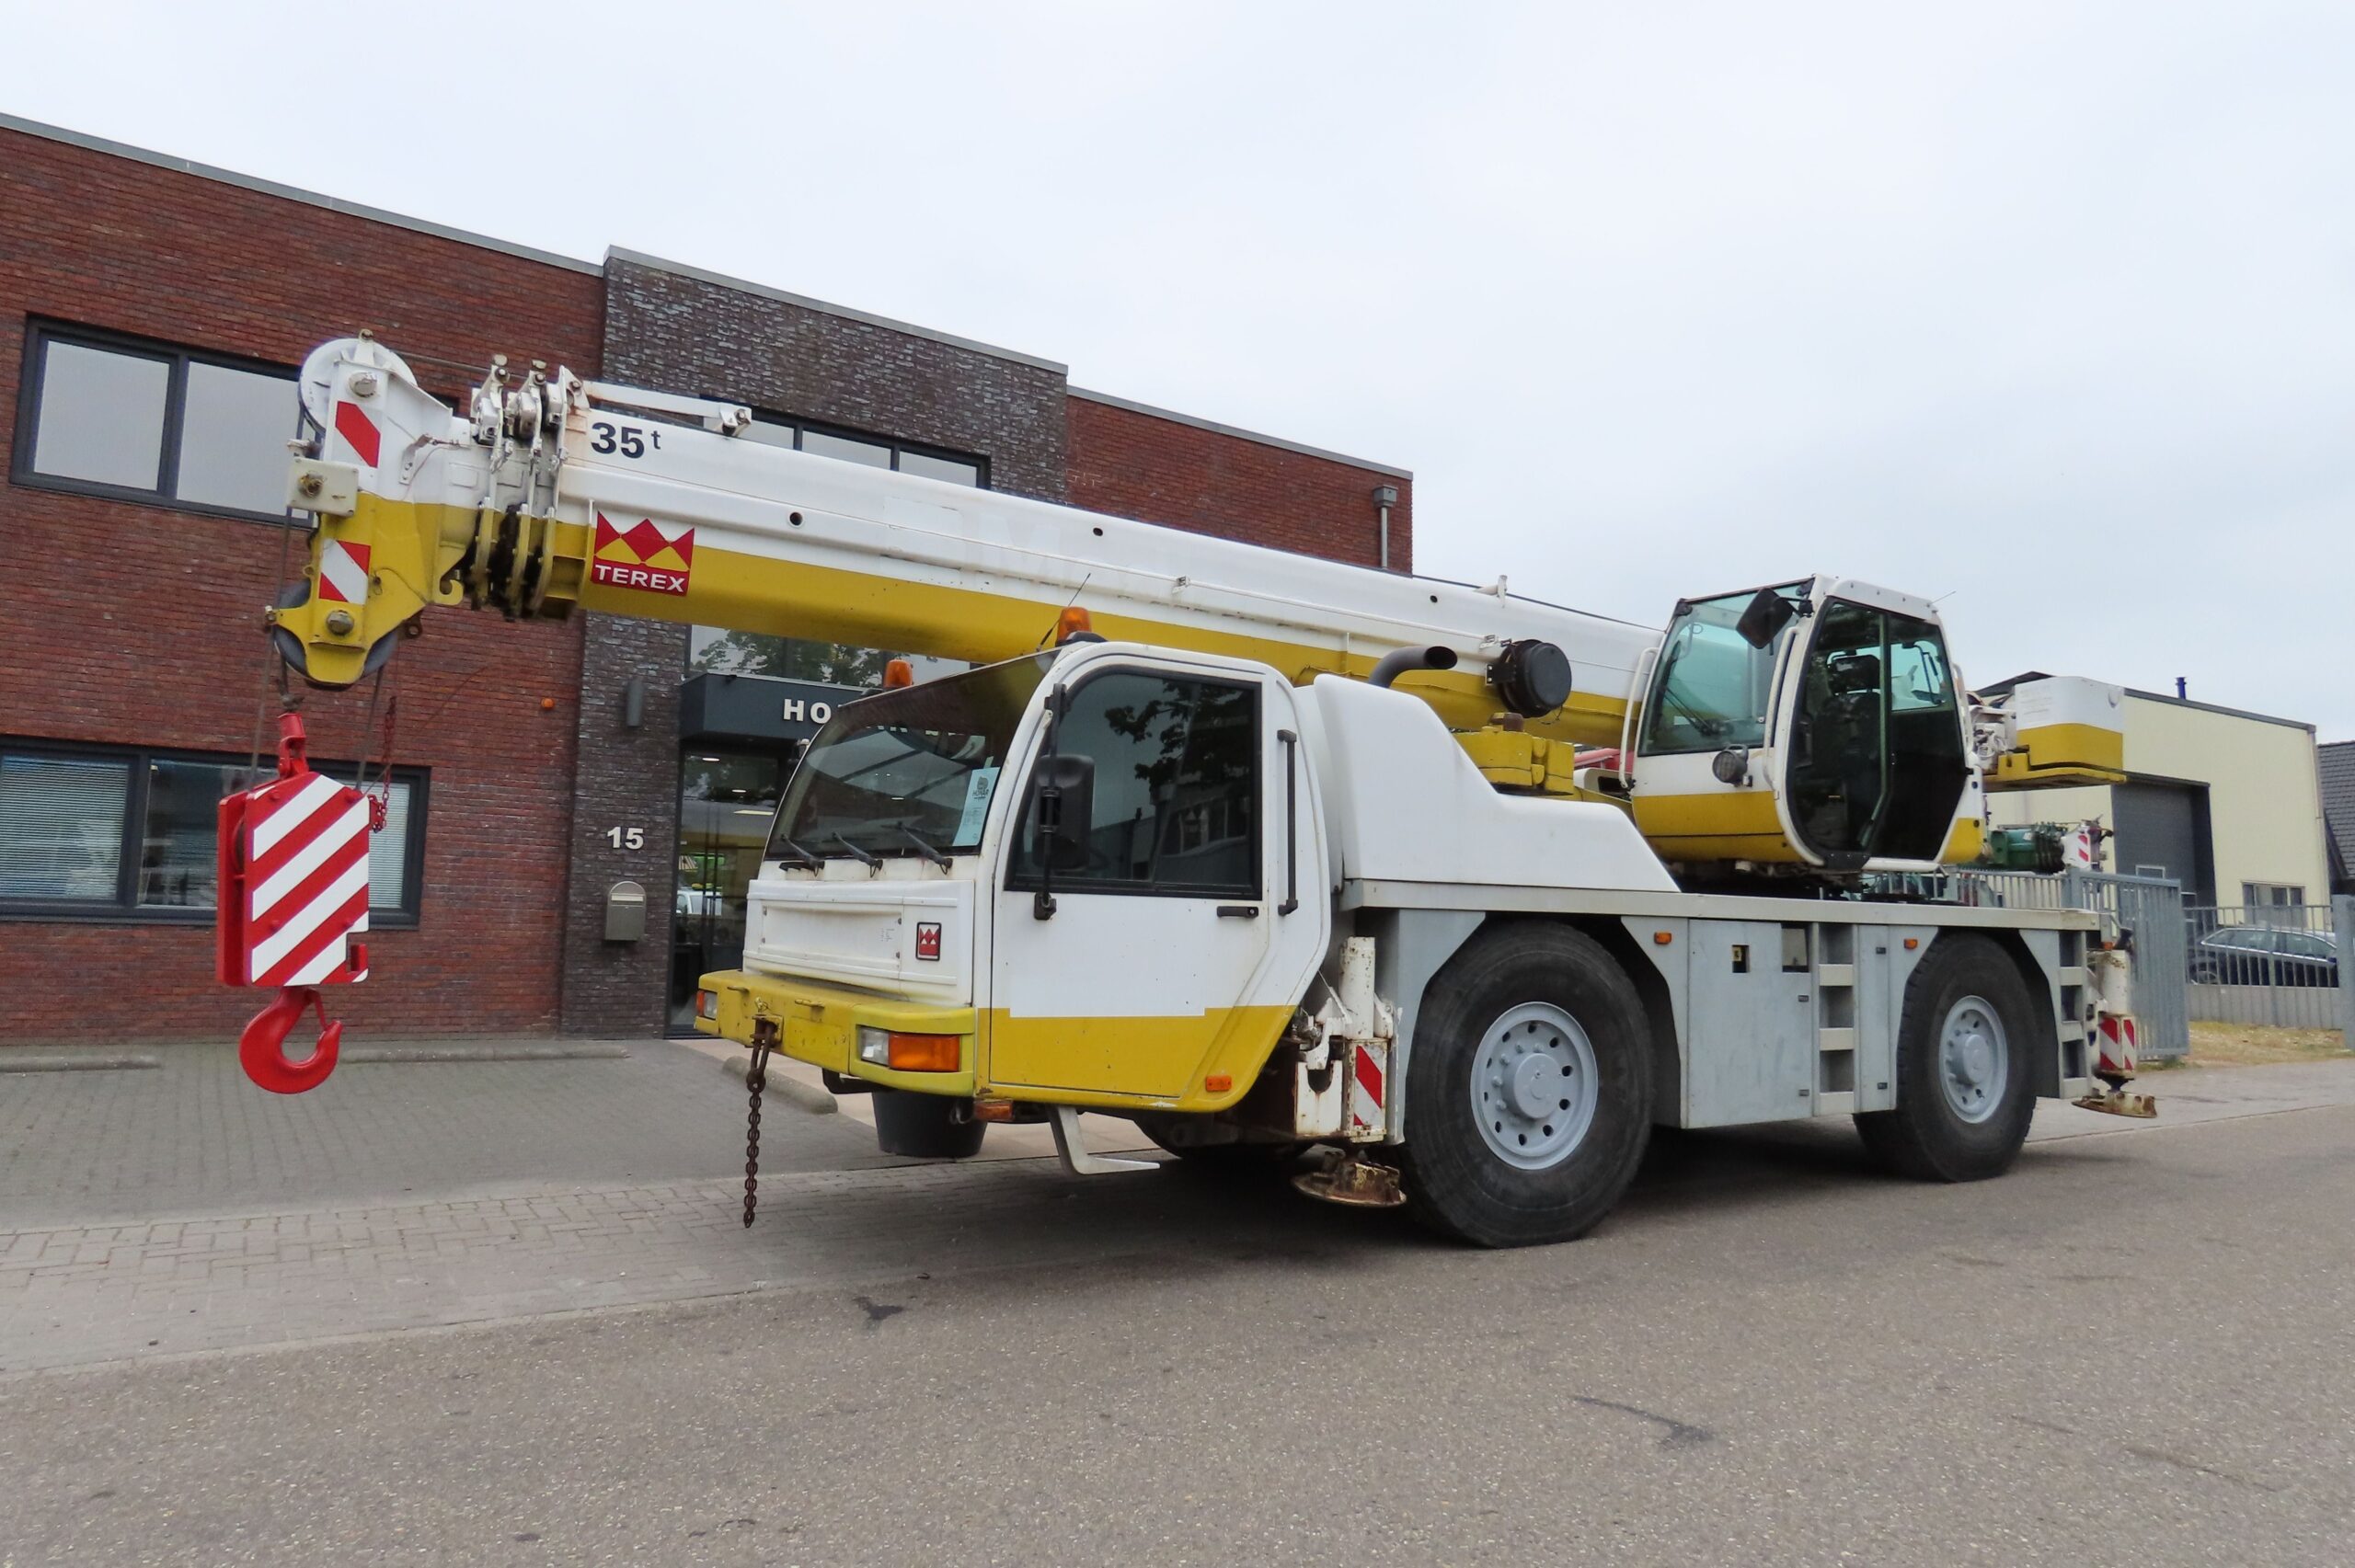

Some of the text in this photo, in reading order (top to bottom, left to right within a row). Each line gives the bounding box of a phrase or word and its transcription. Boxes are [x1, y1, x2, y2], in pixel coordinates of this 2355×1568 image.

[595, 564, 685, 593] TEREX
[783, 698, 832, 725] HO
[607, 826, 644, 850] 15
